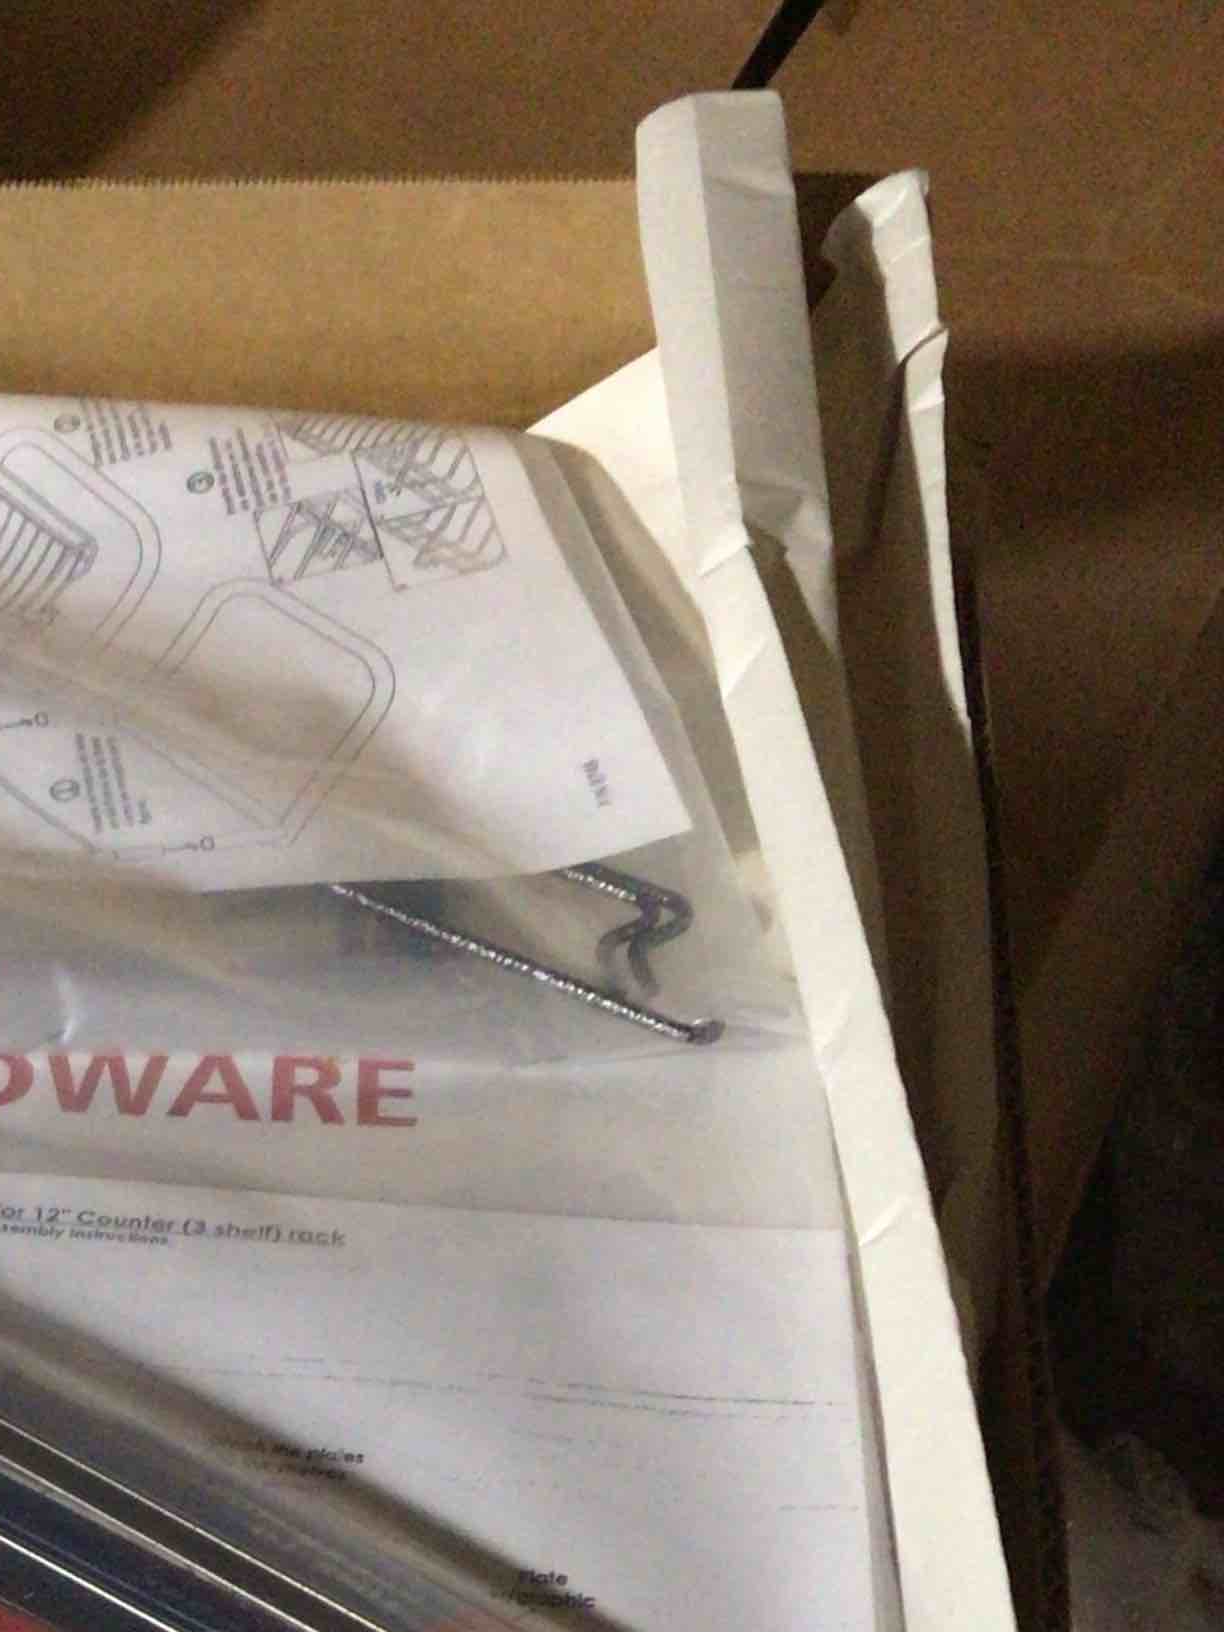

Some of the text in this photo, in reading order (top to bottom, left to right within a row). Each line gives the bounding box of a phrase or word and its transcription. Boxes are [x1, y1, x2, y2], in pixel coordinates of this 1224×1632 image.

[77, 1209, 175, 1233] Counter
[215, 1222, 281, 1243] shelf)
[288, 1226, 347, 1248] rack
